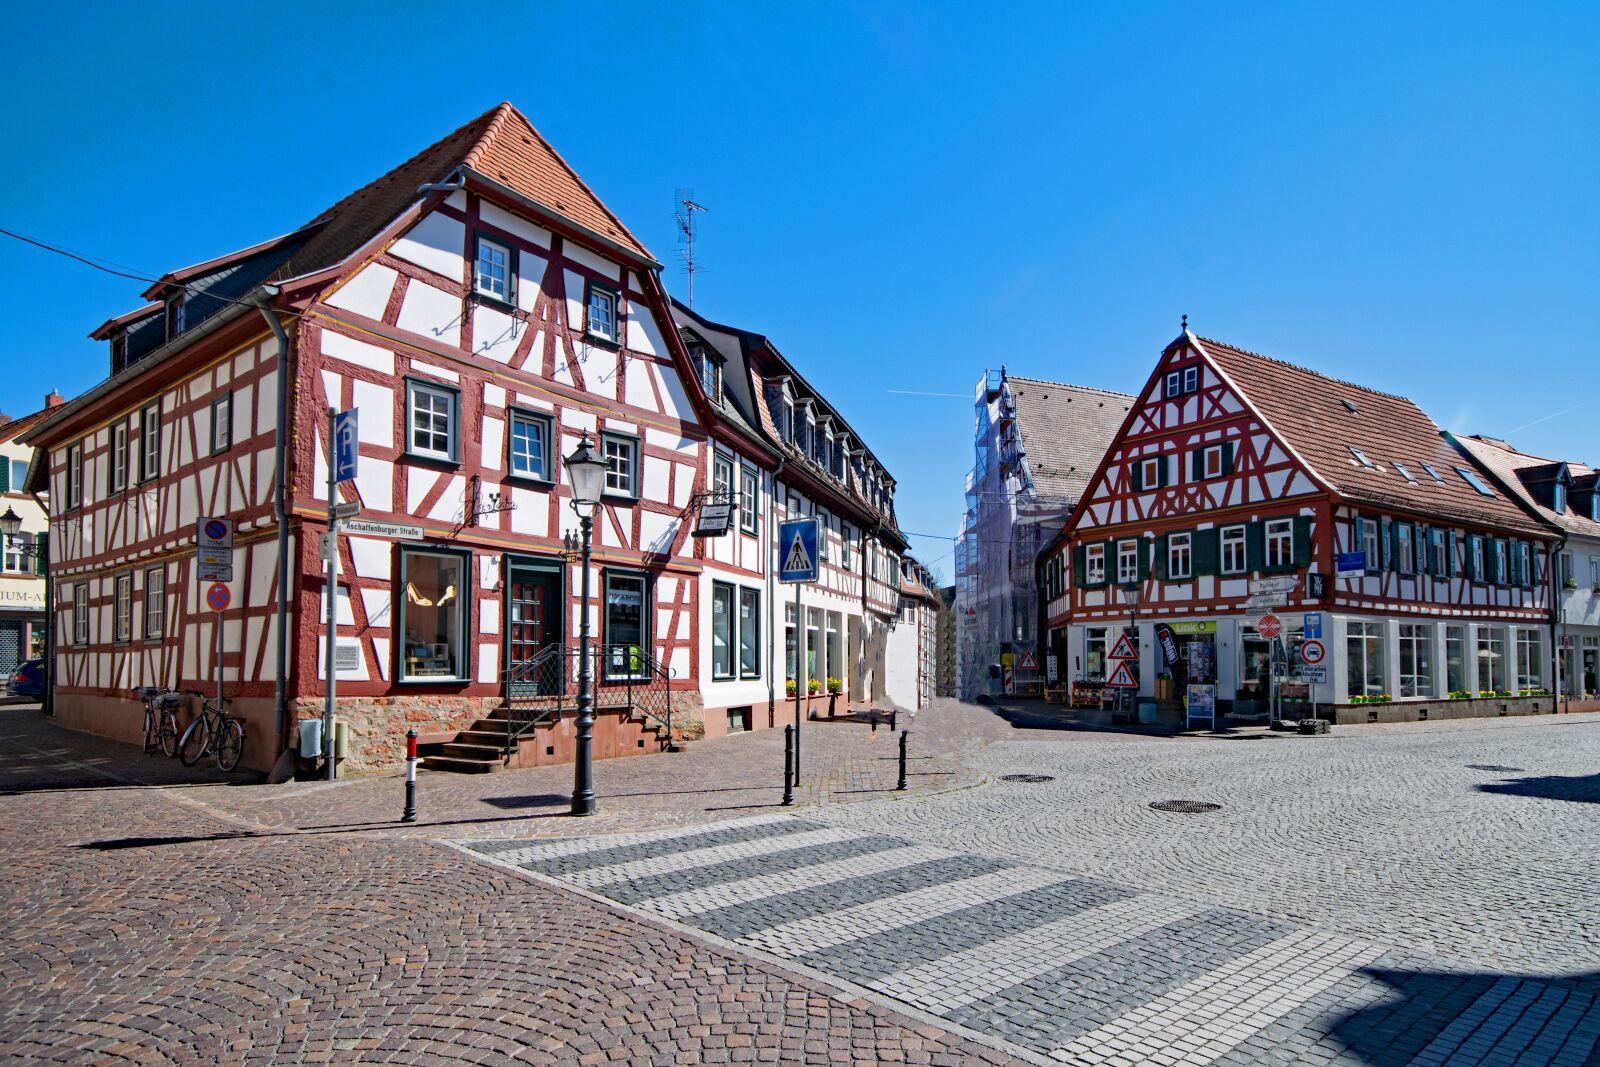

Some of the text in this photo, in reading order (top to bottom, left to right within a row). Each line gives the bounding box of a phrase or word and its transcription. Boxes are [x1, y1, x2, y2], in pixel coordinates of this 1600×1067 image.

[343, 427, 353, 456] P
[346, 523, 419, 536] Aschaffenburger Straße
[0, 591, 45, 602] IUM-A
[1176, 622, 1196, 632] Link
